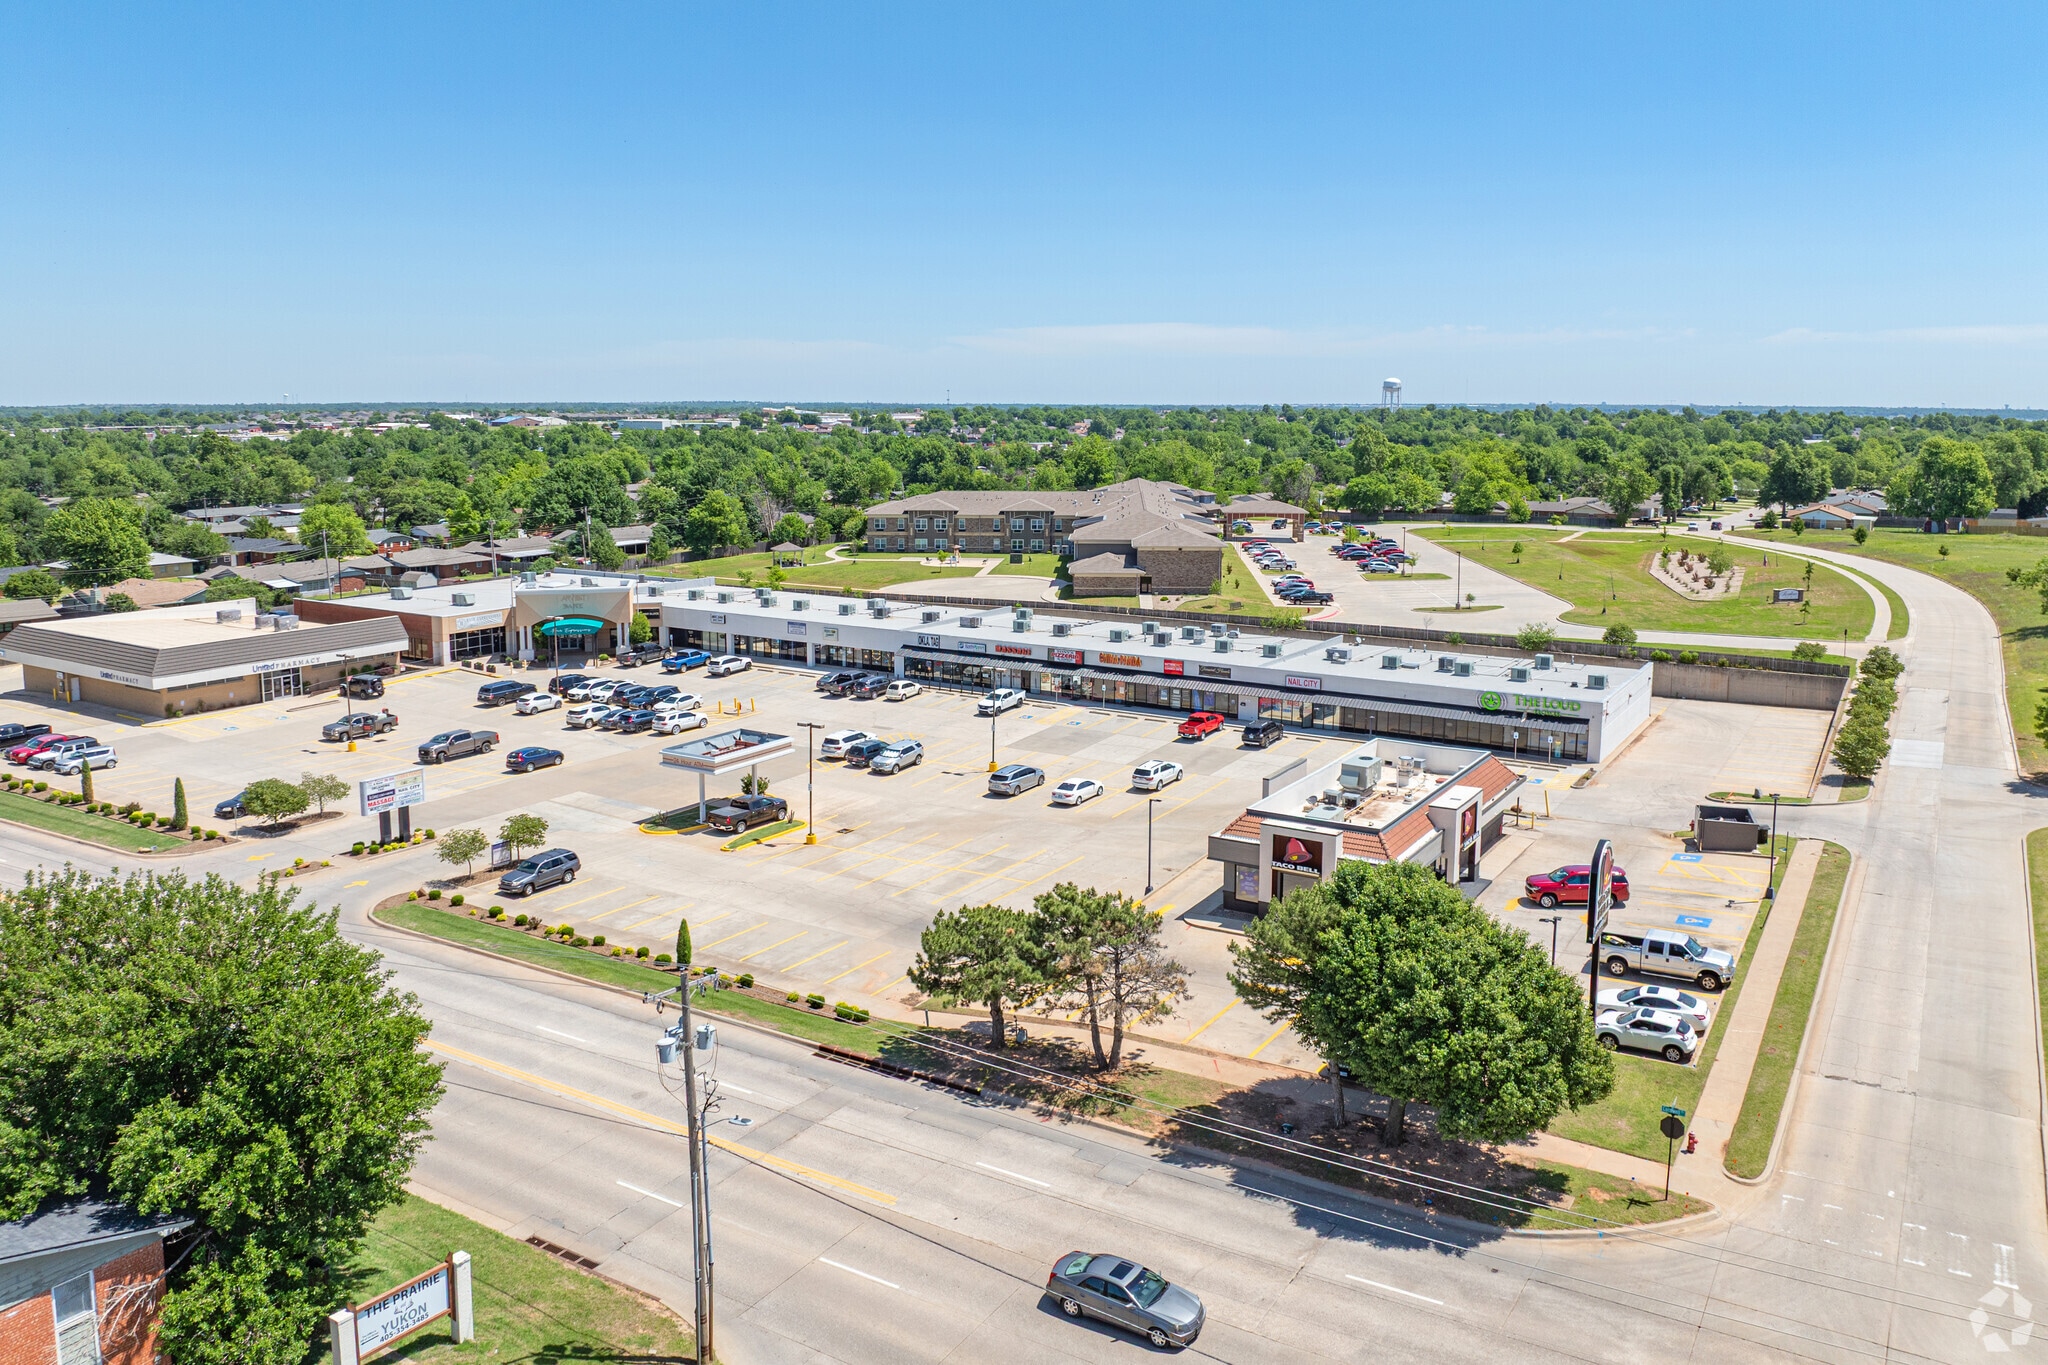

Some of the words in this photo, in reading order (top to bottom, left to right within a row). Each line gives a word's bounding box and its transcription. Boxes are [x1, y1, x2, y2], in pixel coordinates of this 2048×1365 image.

[275, 657, 320, 669] PHARMACY
[1099, 652, 1119, 665] CHINA
[1119, 654, 1142, 668] PANDA
[1288, 677, 1303, 687] NAIL
[1303, 678, 1318, 688] CITY
[1513, 694, 1541, 708] THE
[1542, 697, 1581, 712] LOUD
[368, 796, 394, 808] MASSAGE
[1271, 860, 1296, 870] TACO
[1296, 865, 1320, 875] BELL
[365, 1298, 390, 1319] THE
[393, 1272, 441, 1305] PRAIRIE
[382, 1302, 427, 1335] YUKON
[380, 1311, 429, 1343] 405-354-3485
